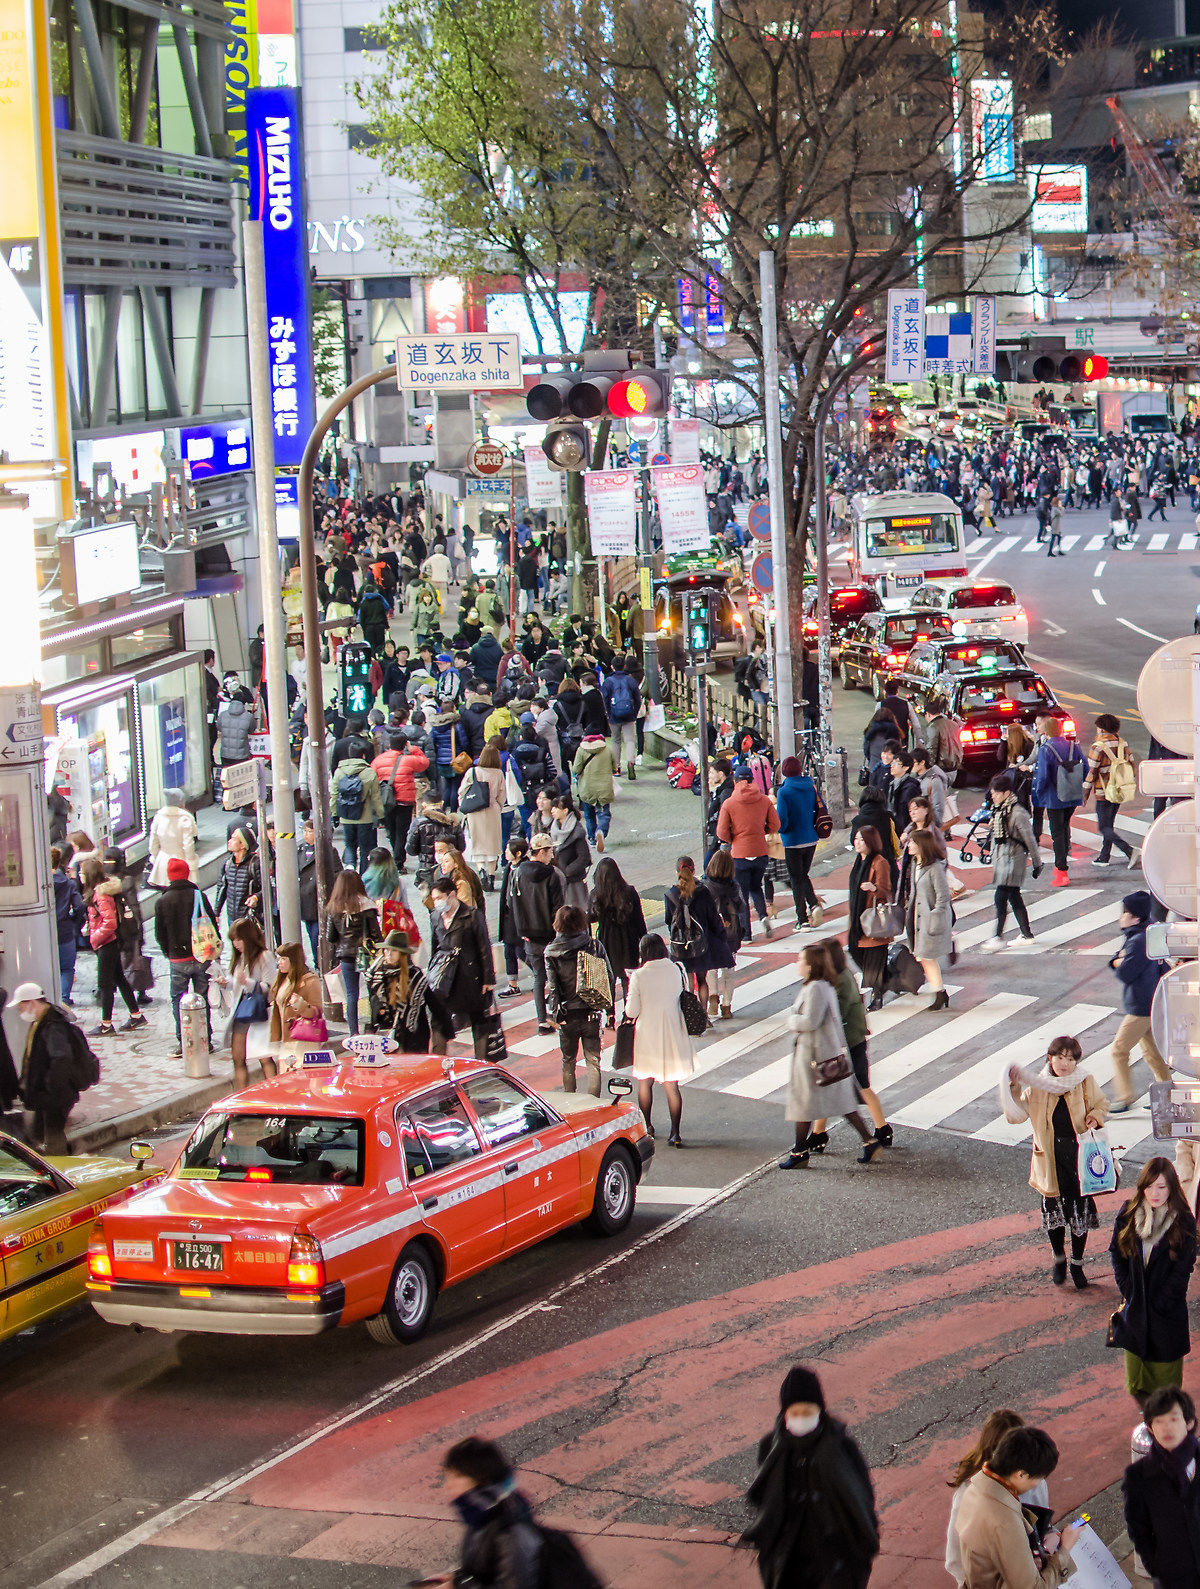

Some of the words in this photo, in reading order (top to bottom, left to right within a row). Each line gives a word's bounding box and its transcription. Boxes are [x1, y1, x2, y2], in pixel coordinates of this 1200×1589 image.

[264, 116, 294, 231] MIZUHO
[892, 305, 902, 346] Dogenzaka
[902, 297, 921, 374] 道玄坂下
[978, 298, 991, 370] スクランブル交差点
[406, 341, 510, 366] 道玄坂下
[926, 360, 970, 374] 時差式
[269, 316, 299, 437] みずほ銀行
[410, 368, 476, 384] Dogenzaka
[481, 368, 510, 381] shita
[475, 453, 503, 466] 消火栓
[354, 1040, 379, 1051] チェッカー
[264, 1117, 287, 1128] 164
[537, 1202, 553, 1218] TAXI
[21, 1228, 46, 1247] DAIWA
[47, 1216, 72, 1235] GROUP
[91, 1200, 109, 1215] TAXI
[185, 1253, 221, 1269] 16-47
[234, 1250, 286, 1264] 太陽自動車
